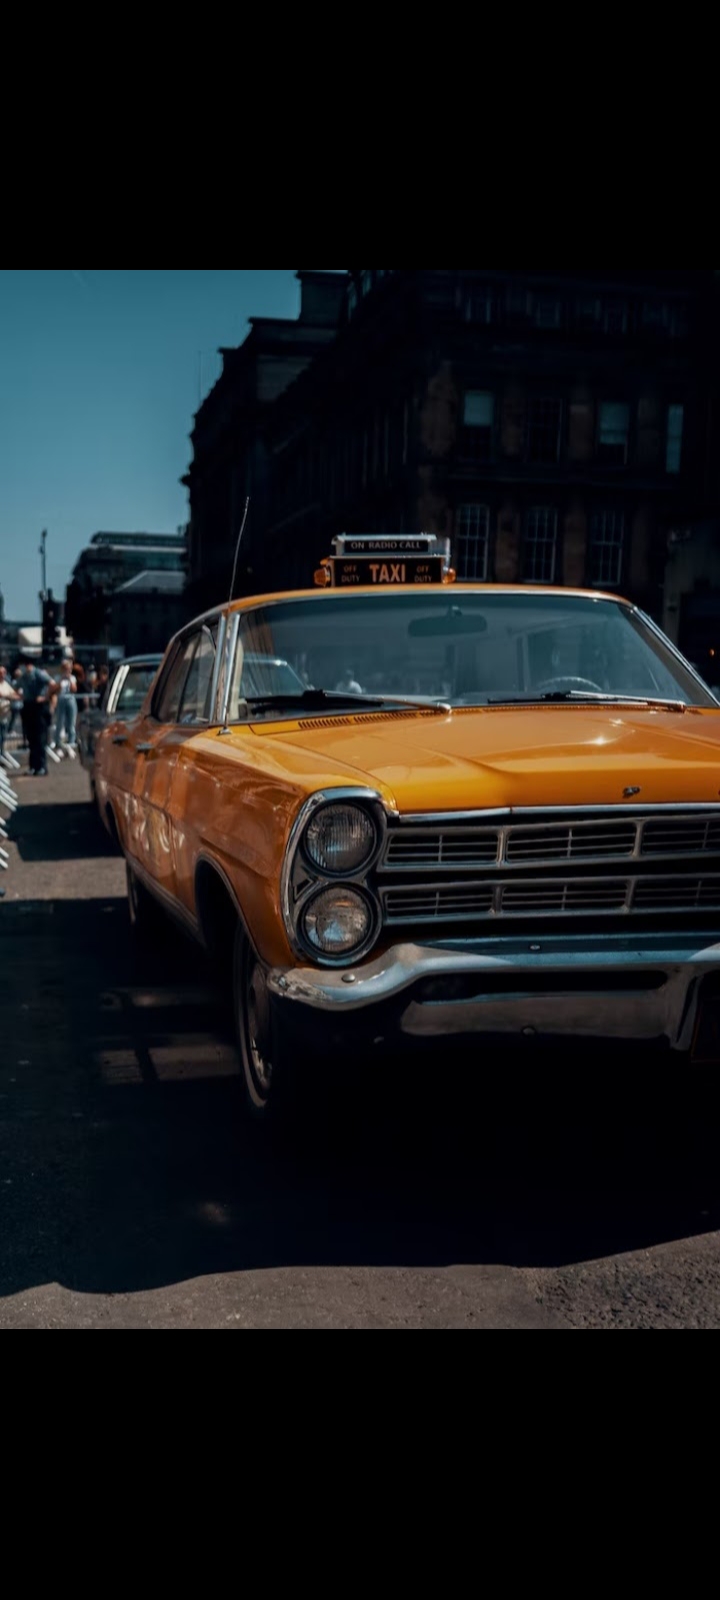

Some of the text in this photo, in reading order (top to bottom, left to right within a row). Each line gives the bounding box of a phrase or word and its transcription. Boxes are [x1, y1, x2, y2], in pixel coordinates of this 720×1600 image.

[350, 541, 421, 550] ON RADIO CALL
[343, 564, 357, 573] OFF
[369, 563, 406, 583] TAXI
[416, 564, 430, 573] OFF
[341, 575, 360, 583] DUTY
[414, 575, 432, 583] DUTY
